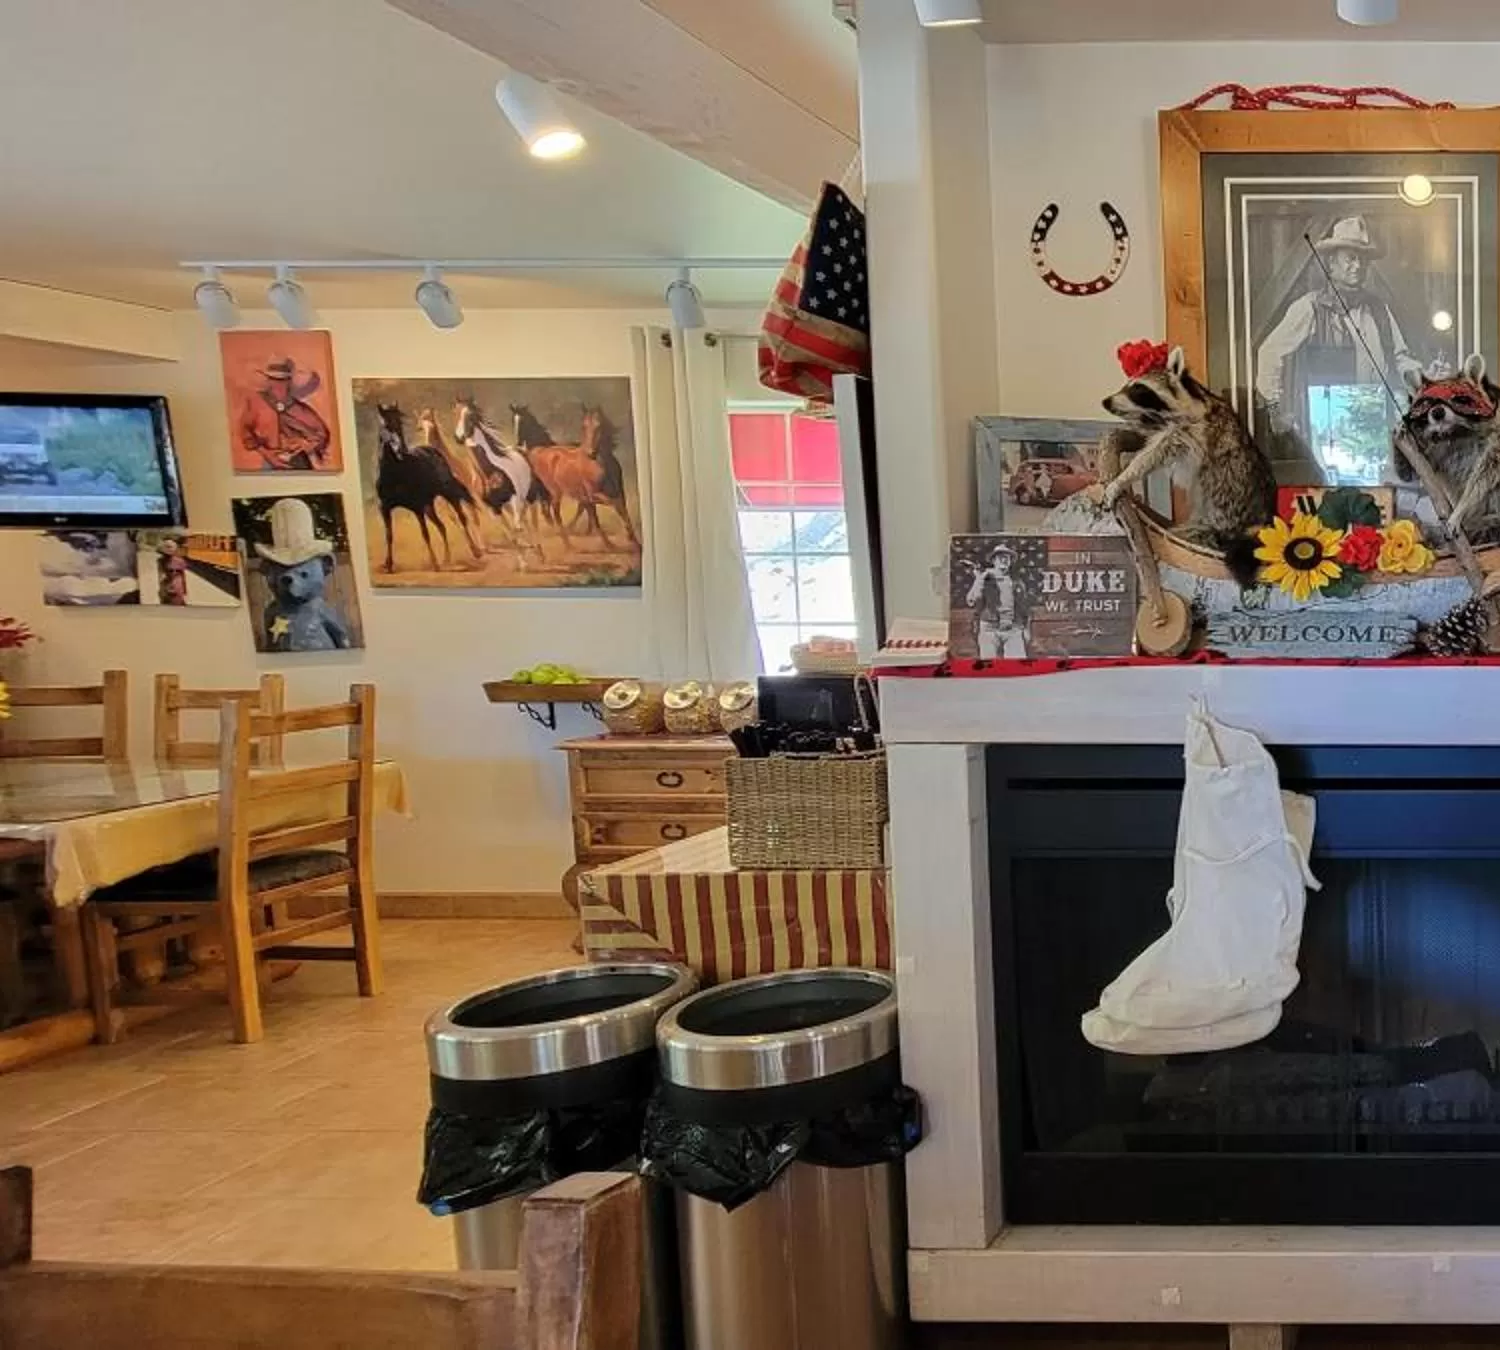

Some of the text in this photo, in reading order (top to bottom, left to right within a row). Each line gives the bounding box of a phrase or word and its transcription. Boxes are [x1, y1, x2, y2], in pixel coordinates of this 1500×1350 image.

[1075, 552, 1092, 565] IN
[1041, 569, 1126, 594] DUKE
[1045, 599, 1122, 613] WE TRUST
[1229, 624, 1398, 643] WELCOME
